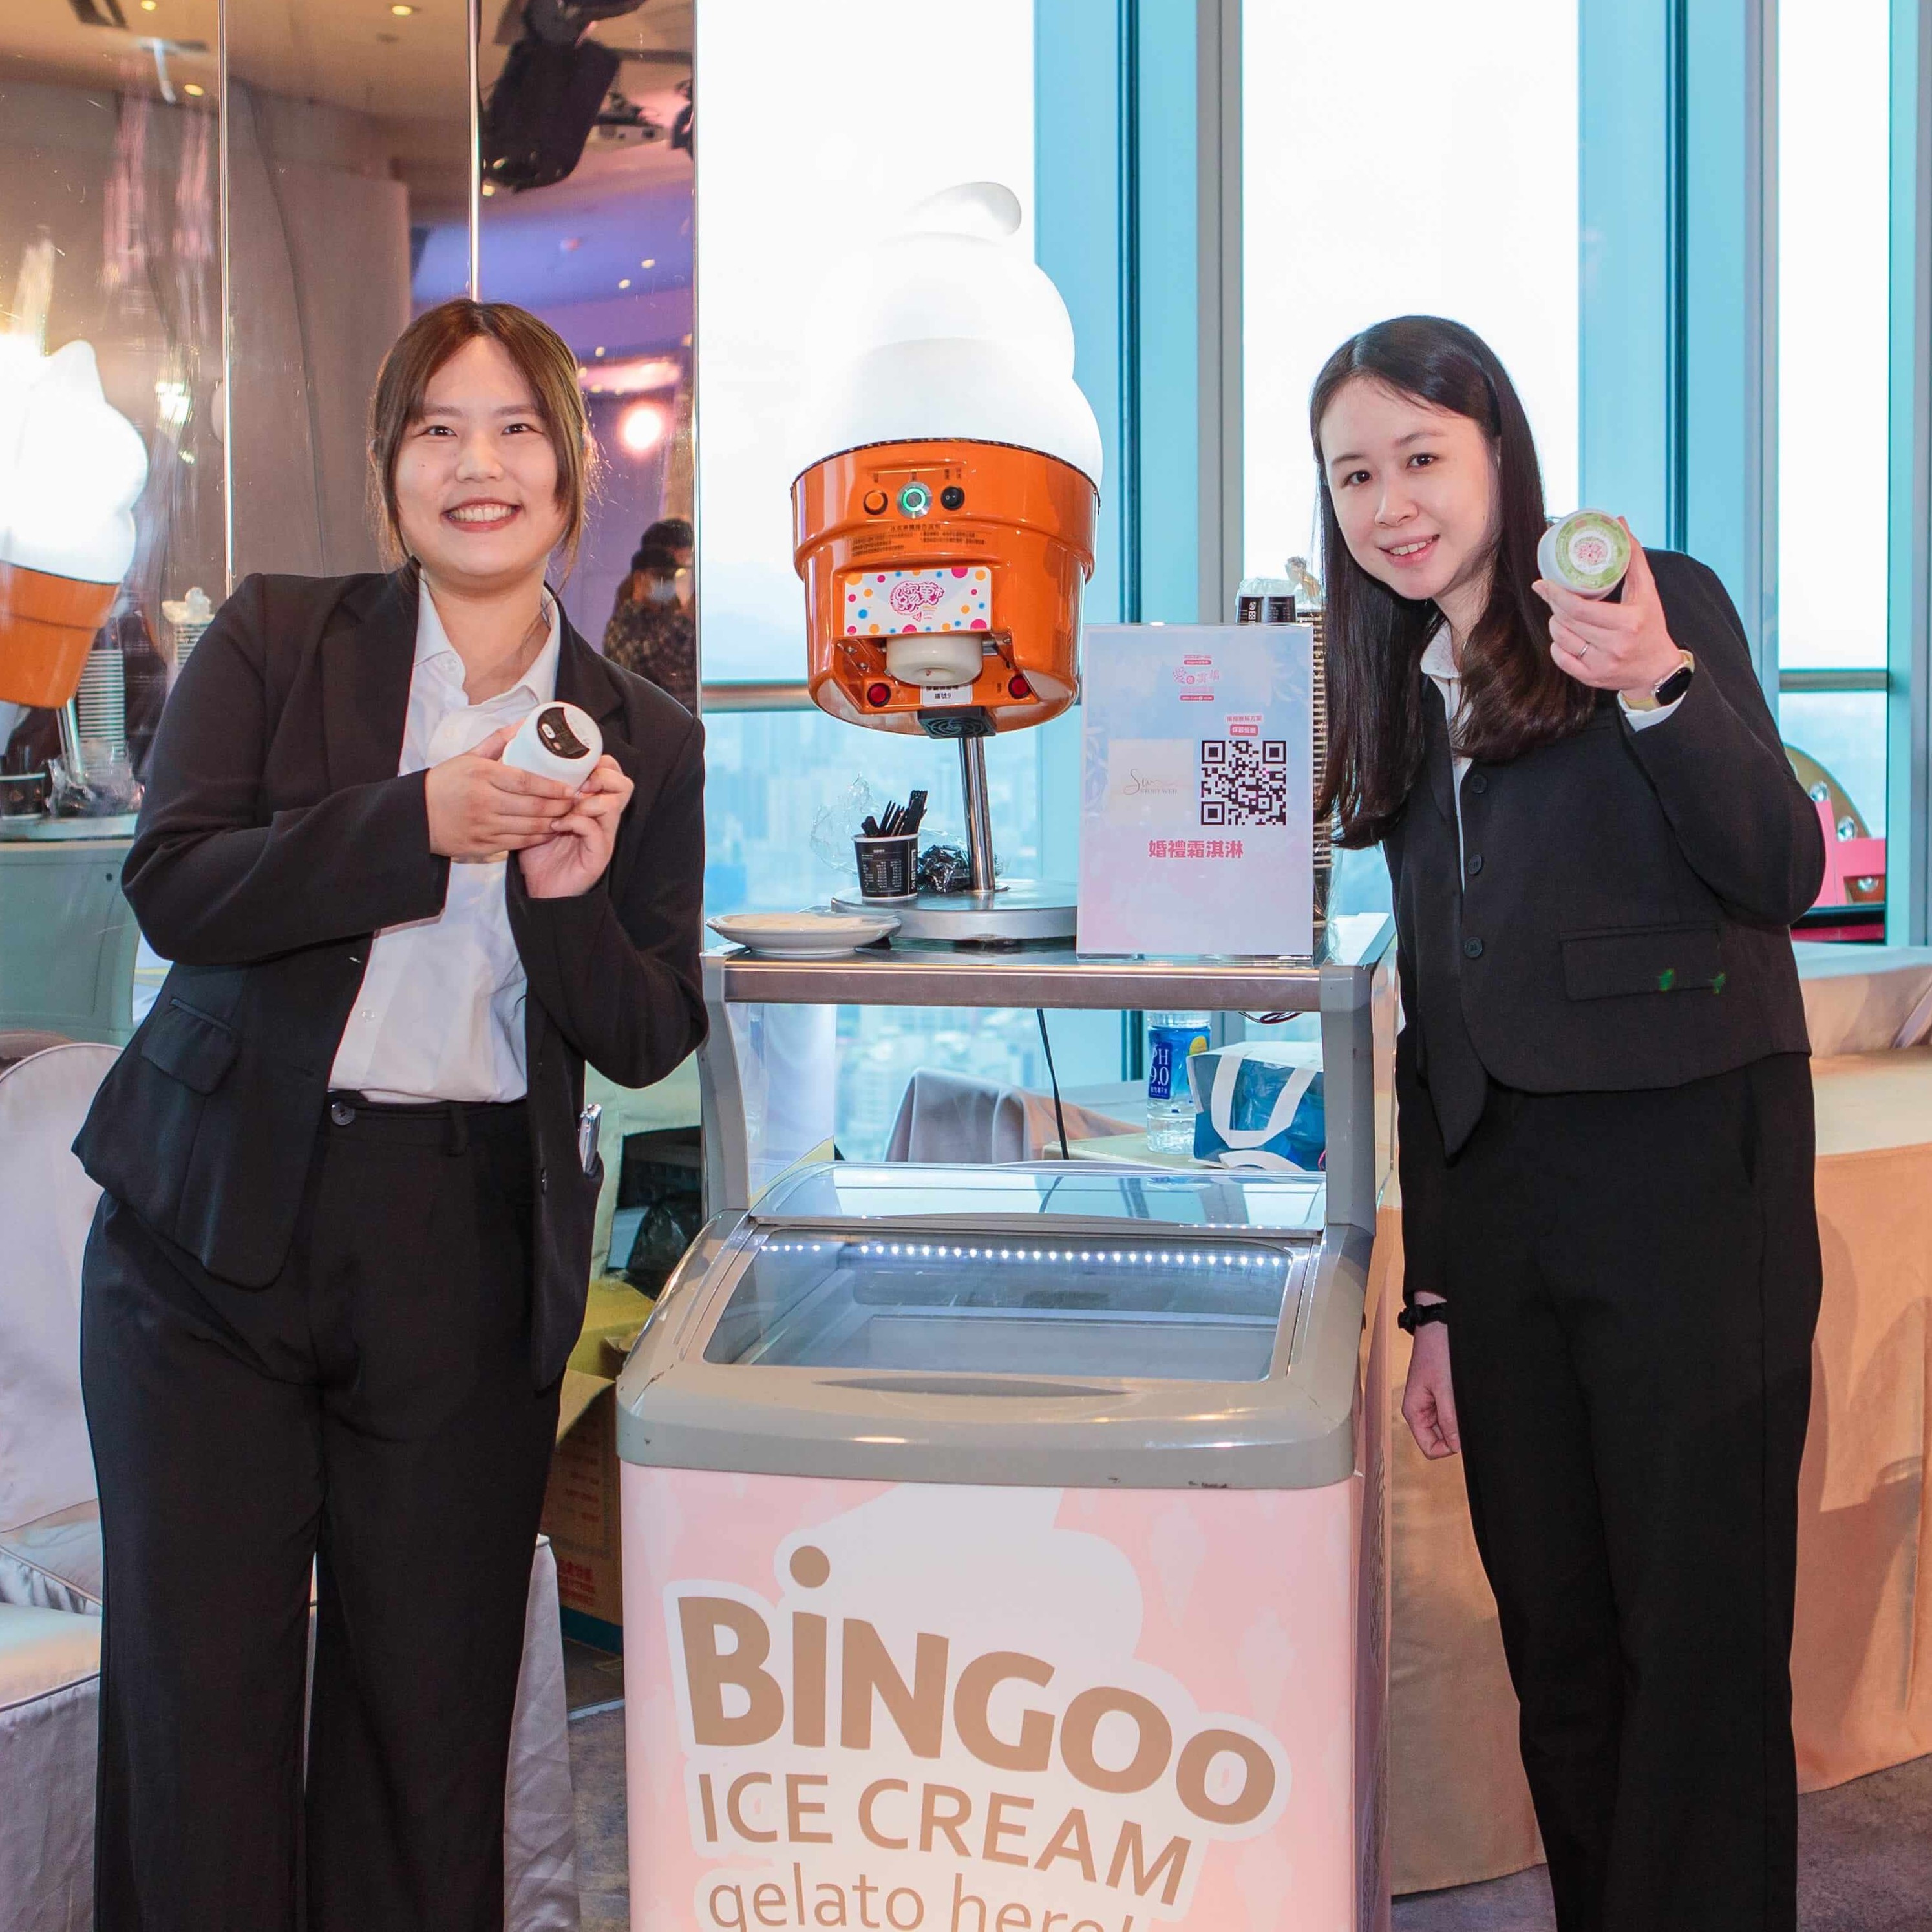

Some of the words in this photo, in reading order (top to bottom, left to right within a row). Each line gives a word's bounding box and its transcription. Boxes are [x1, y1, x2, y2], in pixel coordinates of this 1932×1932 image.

[1148, 840, 1244, 858] 婚禮霜淇淋
[698, 1772, 833, 1843] ICE
[858, 1778, 1192, 1906] CREAM
[709, 1862, 925, 1932] gelato
[951, 1873, 1134, 1932] her
